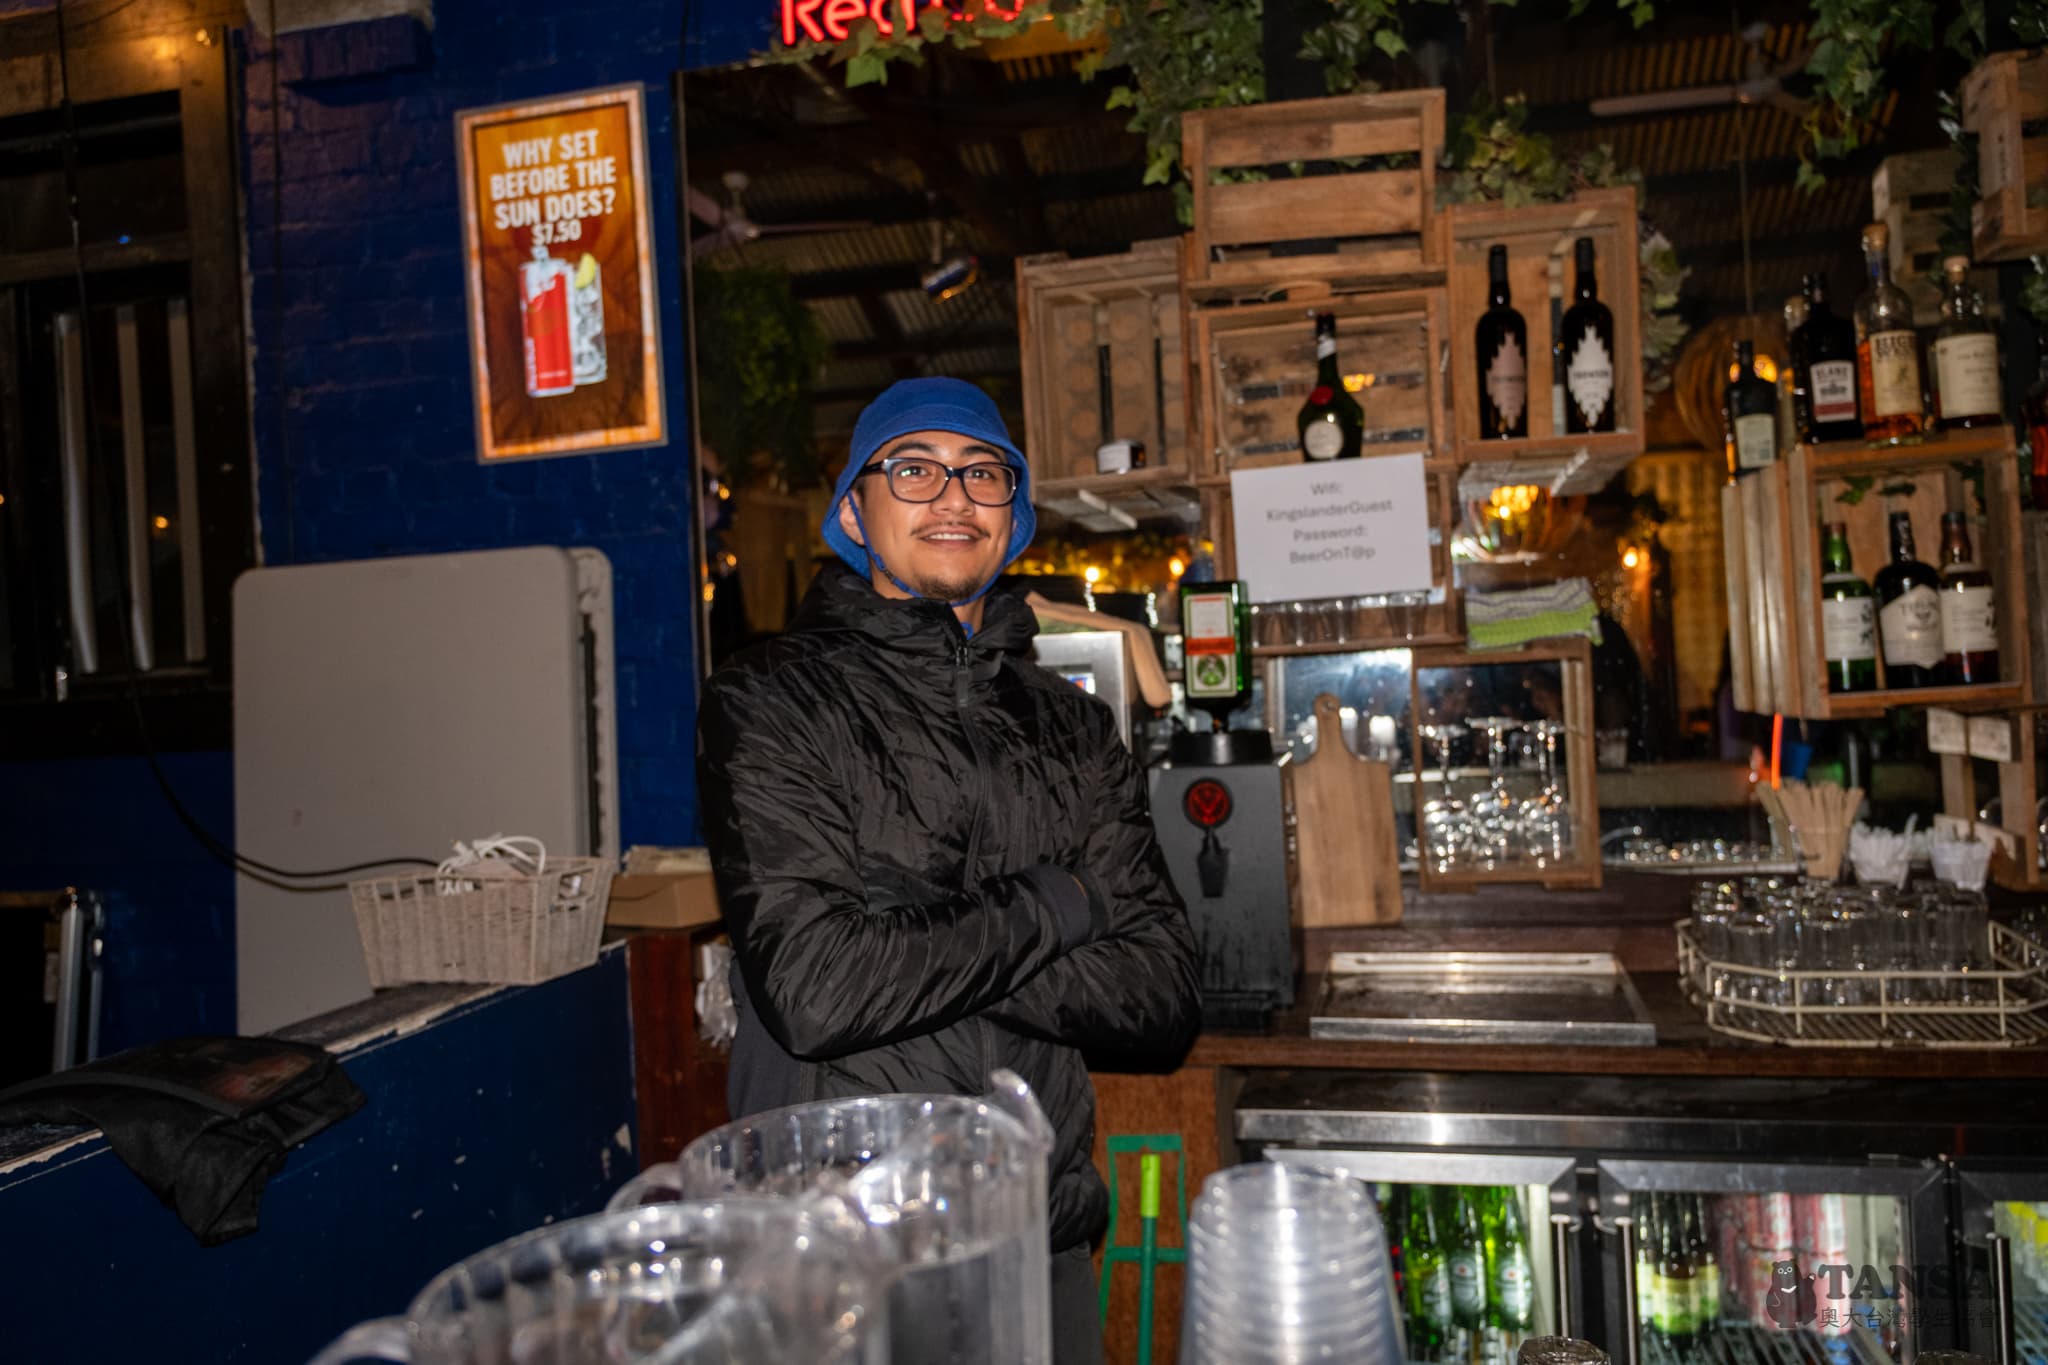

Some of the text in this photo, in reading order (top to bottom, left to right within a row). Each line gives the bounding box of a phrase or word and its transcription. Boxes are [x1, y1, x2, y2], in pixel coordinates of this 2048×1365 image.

[504, 129, 600, 168] WHY SET
[490, 157, 616, 201] BEFORE THE
[494, 188, 615, 230] SUN DOES?
[532, 219, 582, 247] $7.50
[1266, 500, 1393, 523] KingslanderGuest
[1293, 525, 1368, 542] Password:
[1289, 546, 1376, 565] BeerOnT@p
